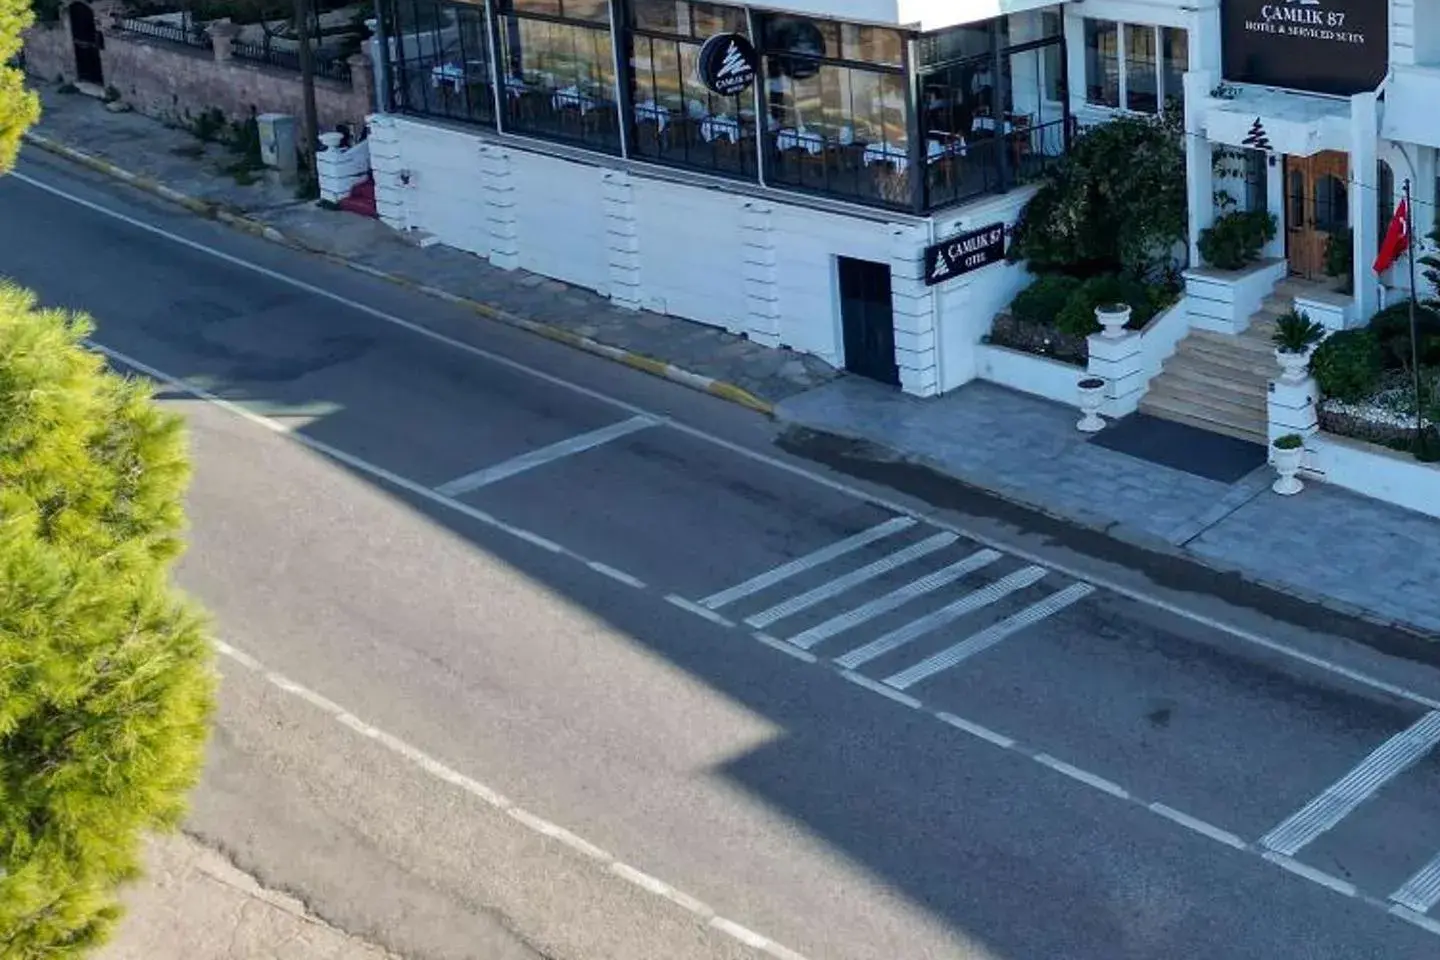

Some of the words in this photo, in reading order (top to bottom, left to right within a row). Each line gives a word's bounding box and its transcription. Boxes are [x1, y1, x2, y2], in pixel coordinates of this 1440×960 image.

[1261, 5, 1323, 25] ÇAMLIK
[1327, 11, 1345, 27] 87
[1245, 20, 1276, 33] HOTEL
[1278, 25, 1286, 34] &
[947, 233, 990, 262] ÇAMLIK
[965, 252, 986, 267] OTEL
